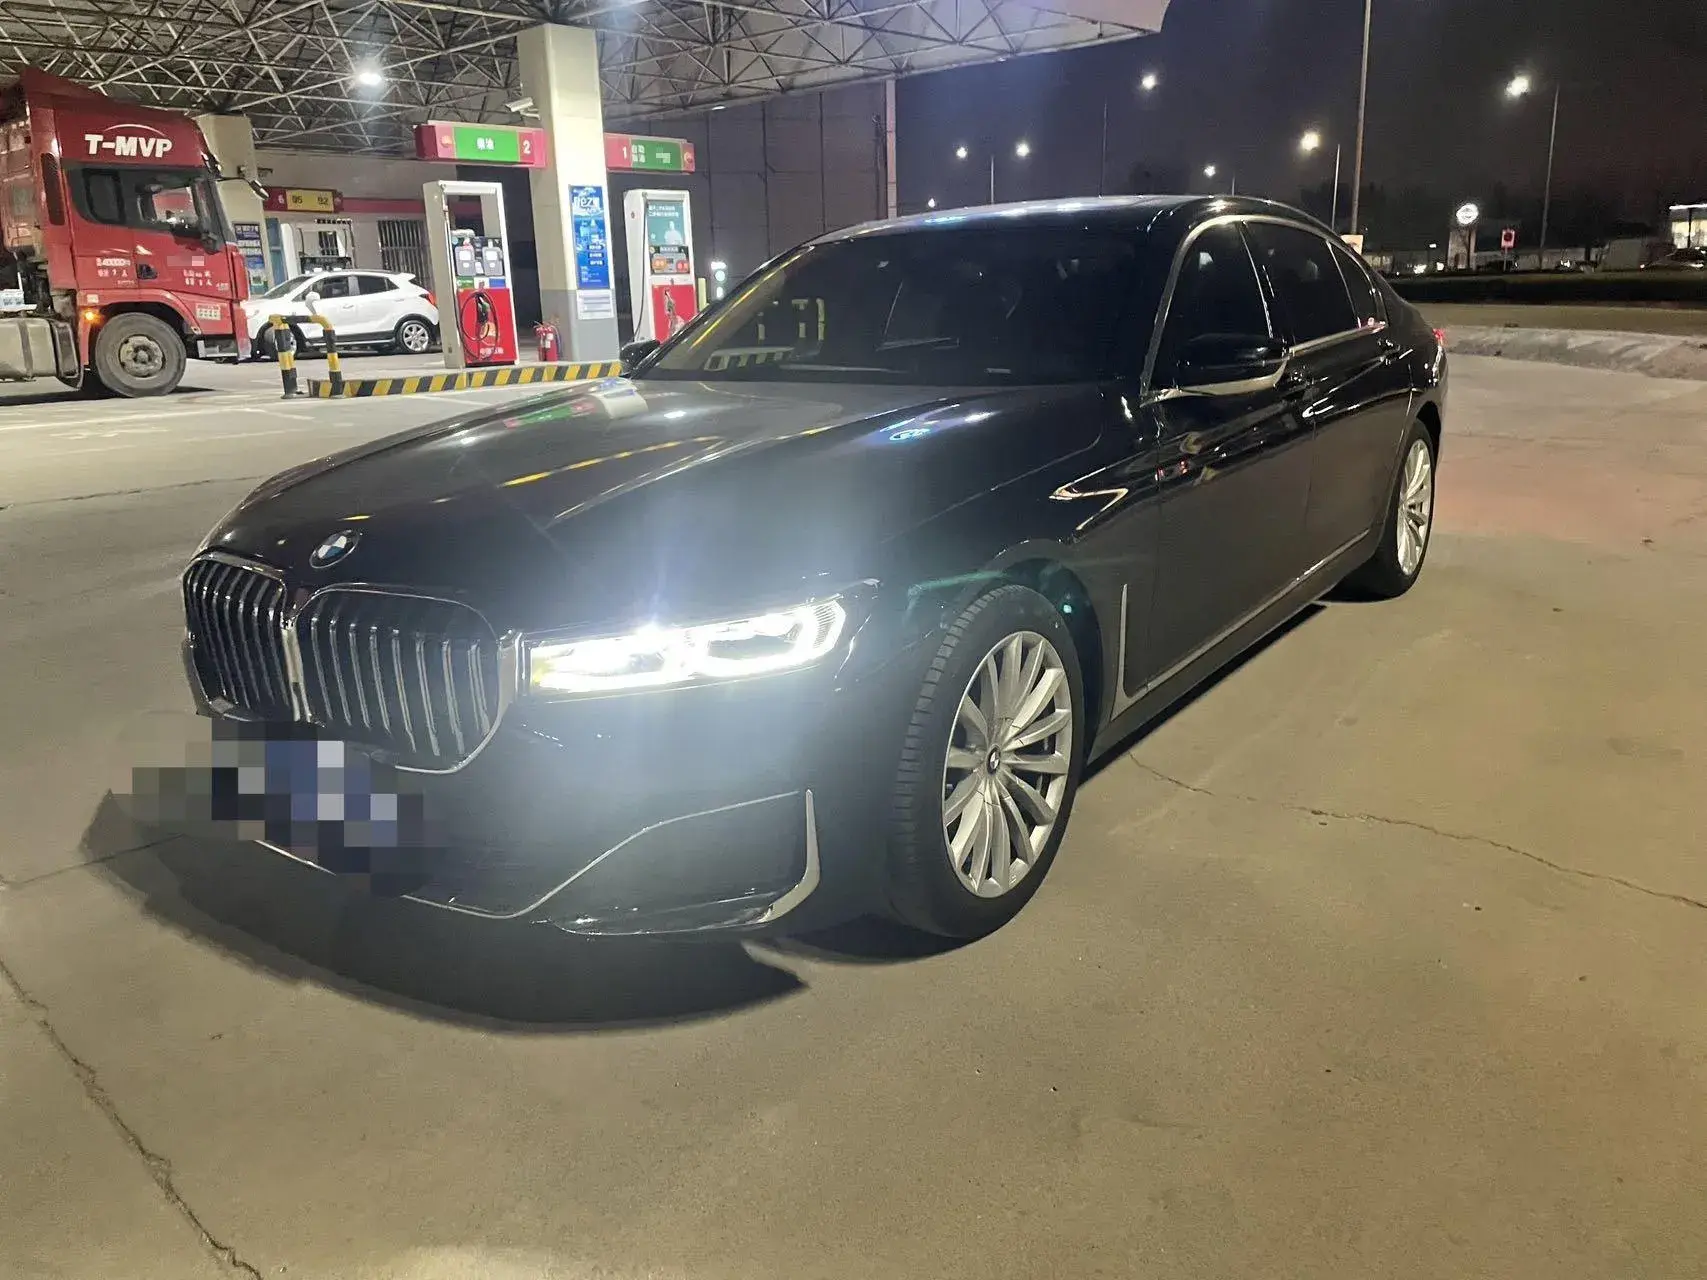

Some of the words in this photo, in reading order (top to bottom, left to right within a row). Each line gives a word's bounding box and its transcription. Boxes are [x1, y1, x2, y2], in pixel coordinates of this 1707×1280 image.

[85, 134, 172, 158] T-MVP
[523, 139, 531, 155] 2
[622, 146, 628, 160] 1
